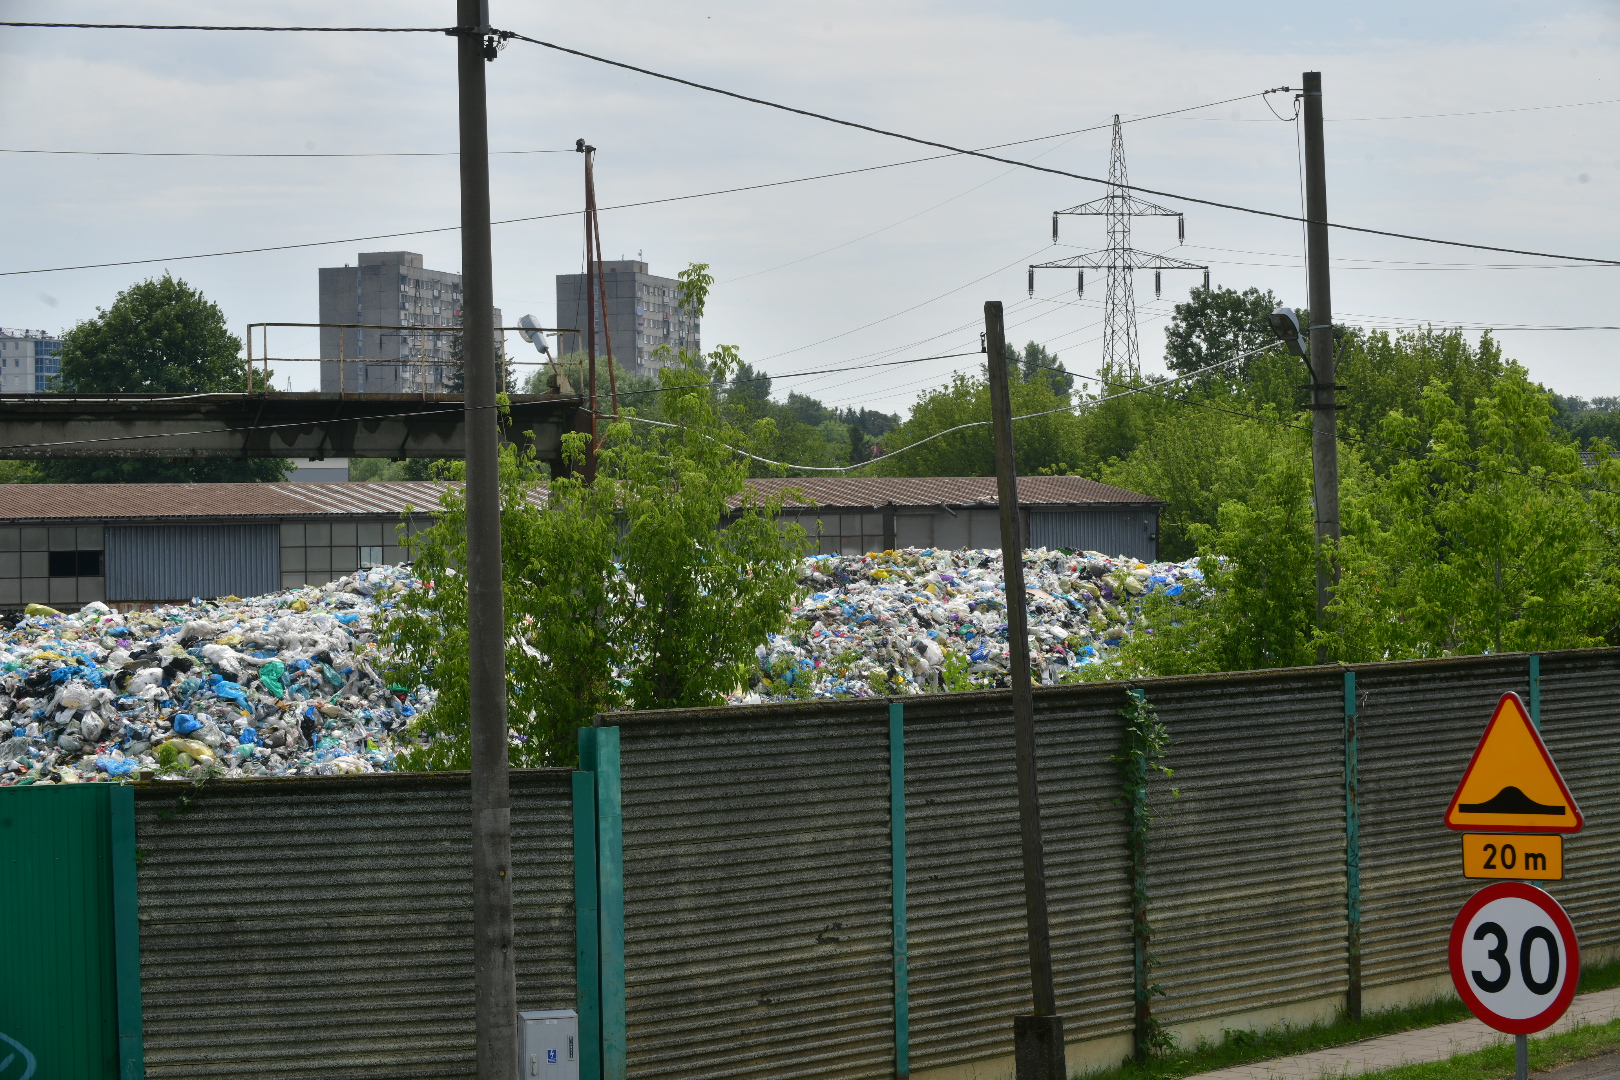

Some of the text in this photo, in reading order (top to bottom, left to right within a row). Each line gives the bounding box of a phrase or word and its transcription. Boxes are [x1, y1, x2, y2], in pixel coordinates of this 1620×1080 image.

[1483, 843, 1547, 870] 20 m
[1471, 921, 1560, 996] 30
